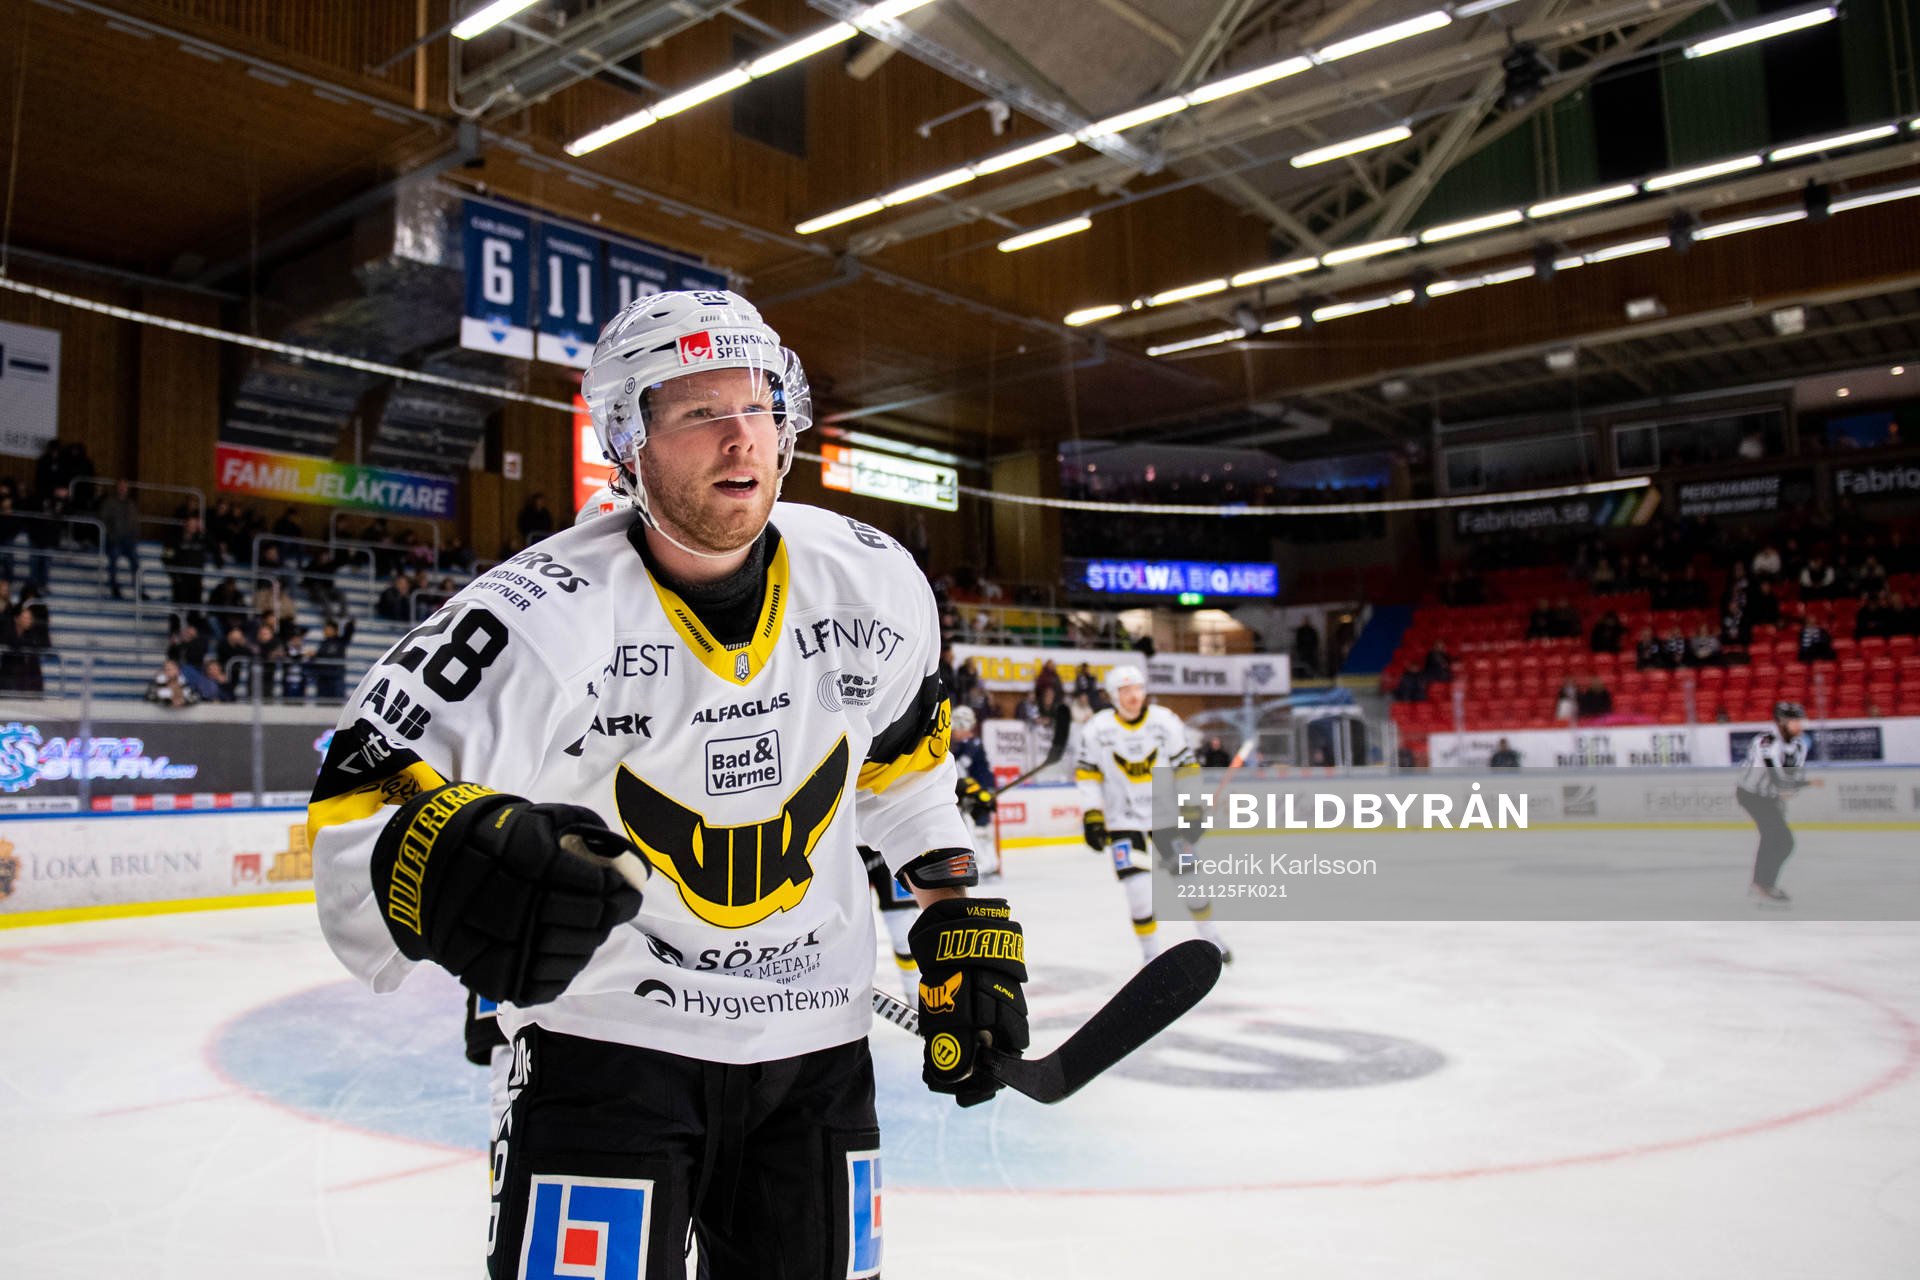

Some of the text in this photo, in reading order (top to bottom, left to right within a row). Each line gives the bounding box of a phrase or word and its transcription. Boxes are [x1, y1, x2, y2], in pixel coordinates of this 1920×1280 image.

[482, 237, 514, 306] 6
[548, 254, 594, 326] 11
[222, 458, 449, 514] FAMILJELÄKTARE
[472, 582, 532, 612] PARTNER
[763, 584, 781, 638] WARRIOR
[382, 601, 508, 702] 28
[674, 608, 715, 653] WARRIOR
[360, 677, 431, 741] ABB
[691, 692, 791, 726] ALFAGLAS
[712, 737, 775, 770] Bad &
[712, 766, 776, 789] Värme
[615, 732, 850, 929] VIK
[31, 849, 201, 882] LOKA BRUNN
[682, 987, 849, 1019] Hygienteknik
